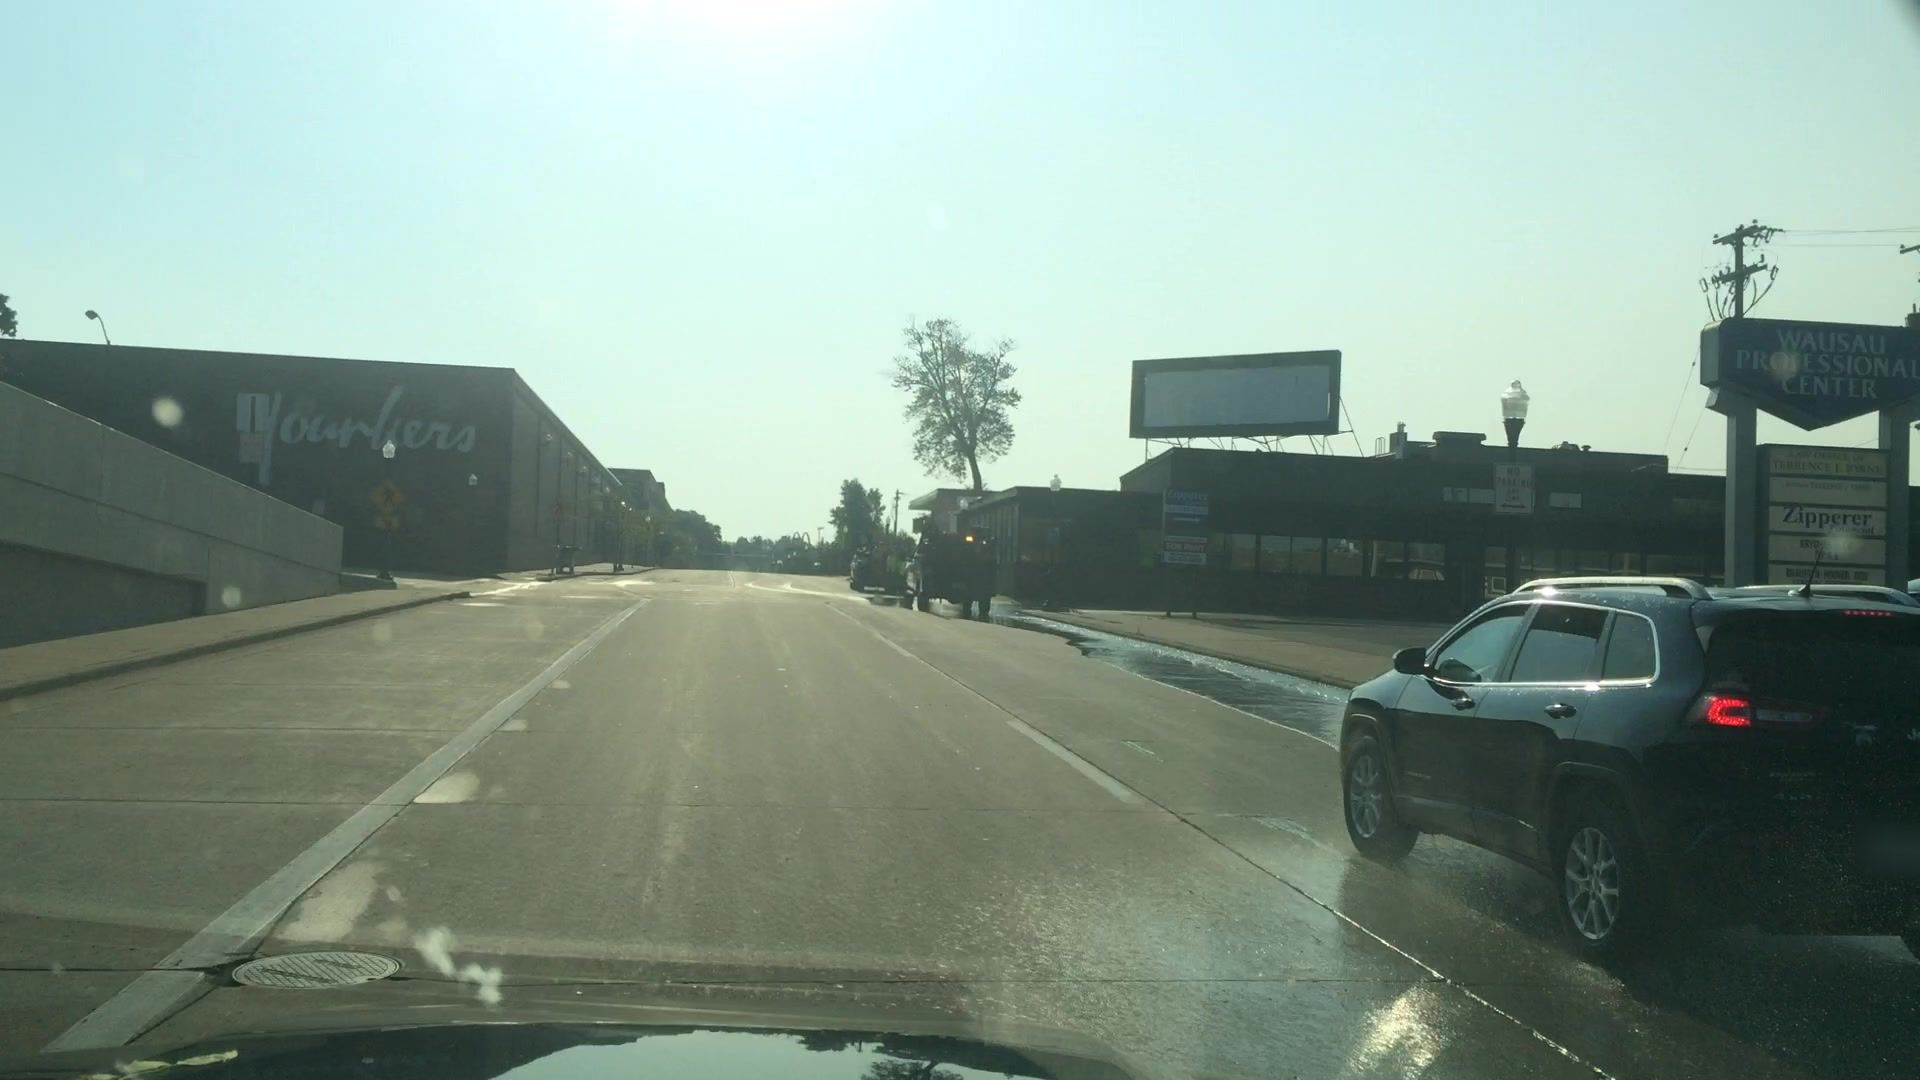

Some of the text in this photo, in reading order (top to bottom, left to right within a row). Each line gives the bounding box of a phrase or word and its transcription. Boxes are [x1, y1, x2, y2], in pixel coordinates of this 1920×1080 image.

[1776, 327, 1886, 354] WAUSAU
[1780, 375, 1879, 399] CENTER
[1782, 505, 1872, 528] Zipperer
